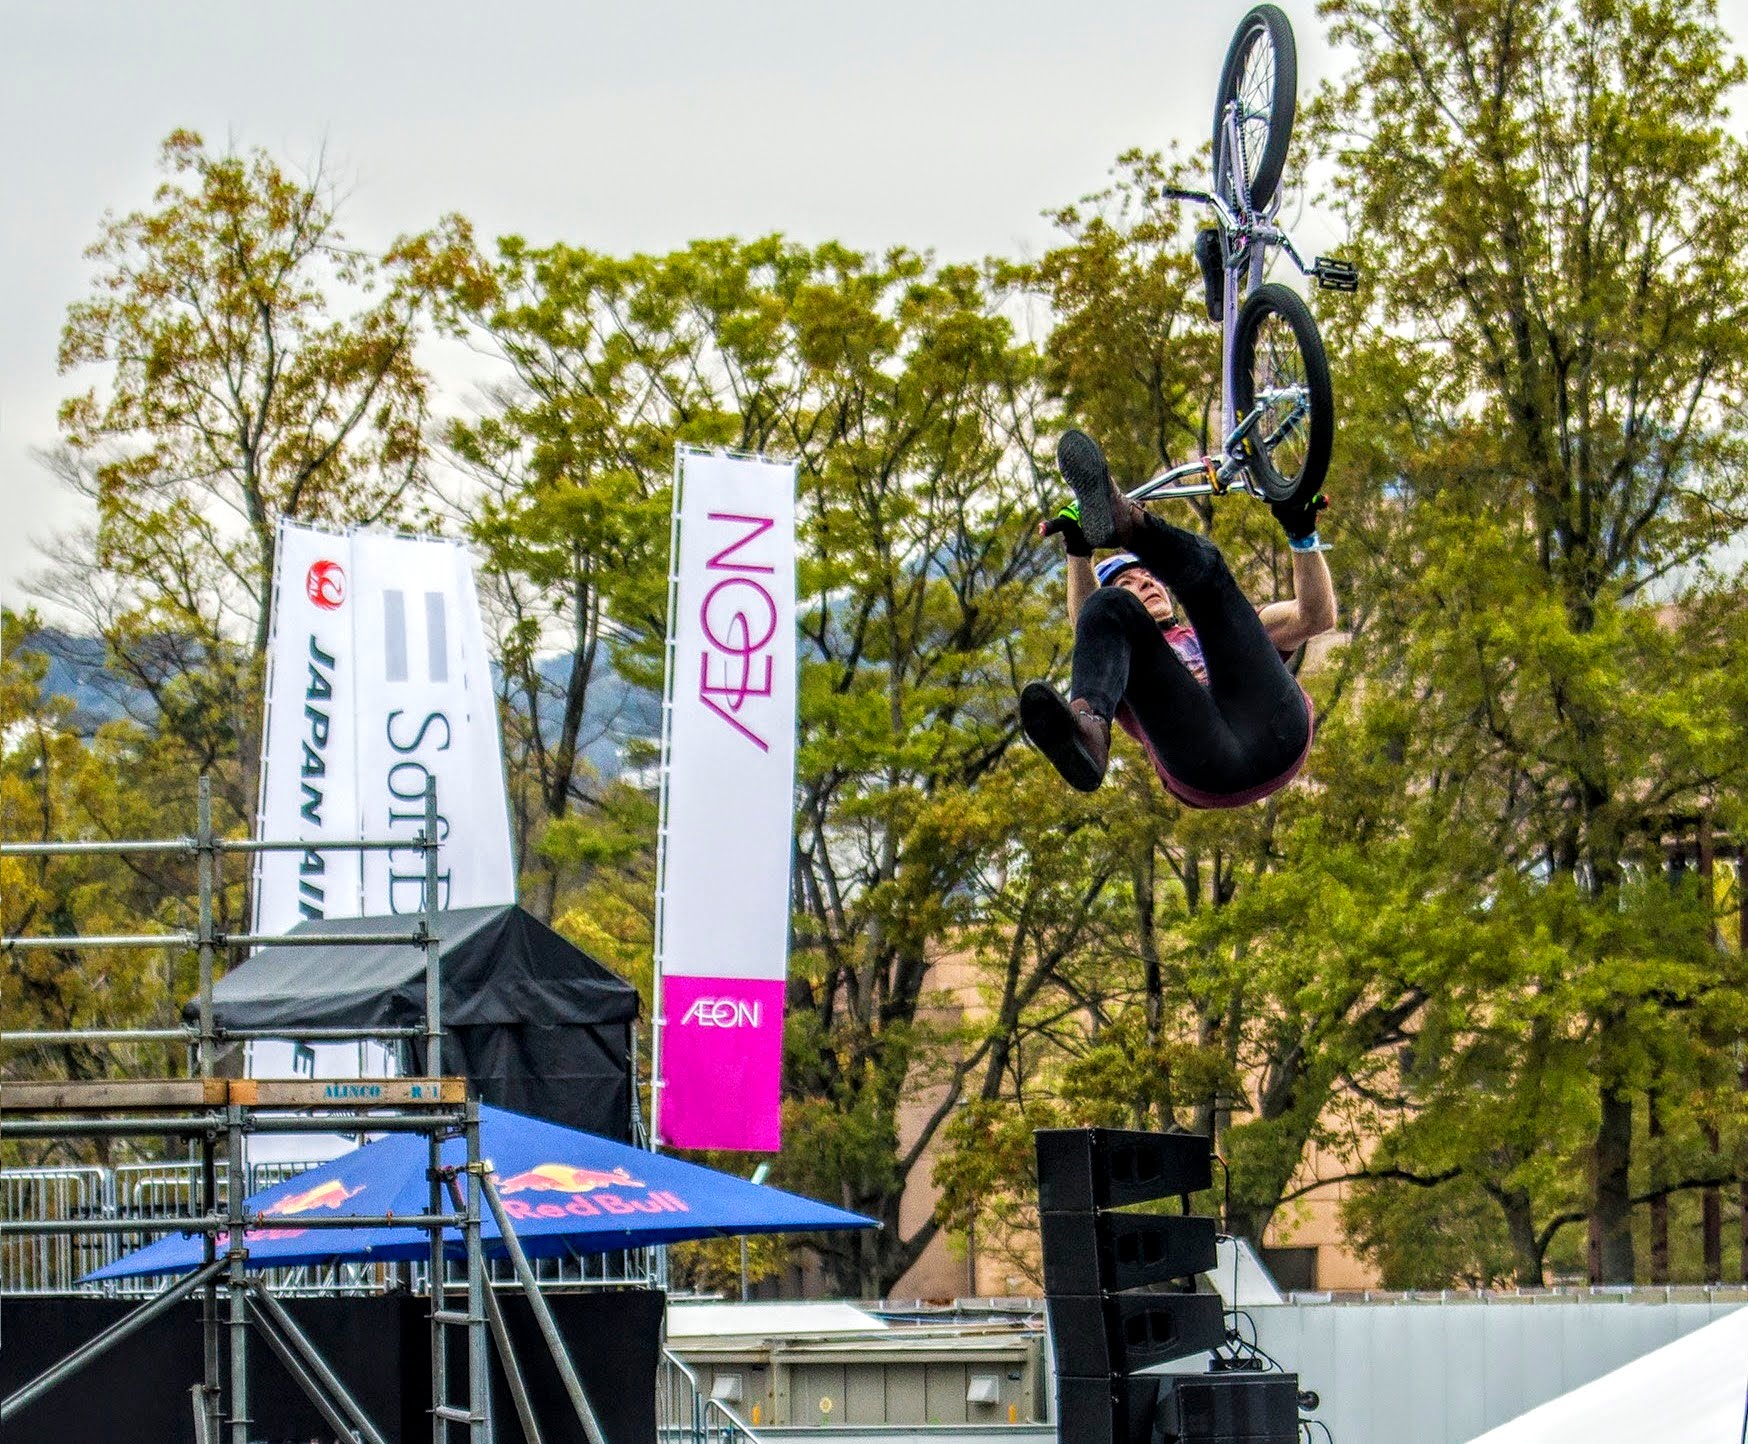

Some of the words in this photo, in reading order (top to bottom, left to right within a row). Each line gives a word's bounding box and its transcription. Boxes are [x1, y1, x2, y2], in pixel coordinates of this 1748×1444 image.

[300, 634, 336, 828] JAPAN
[501, 1194, 601, 1219] Red
[593, 1190, 690, 1214] Bull
